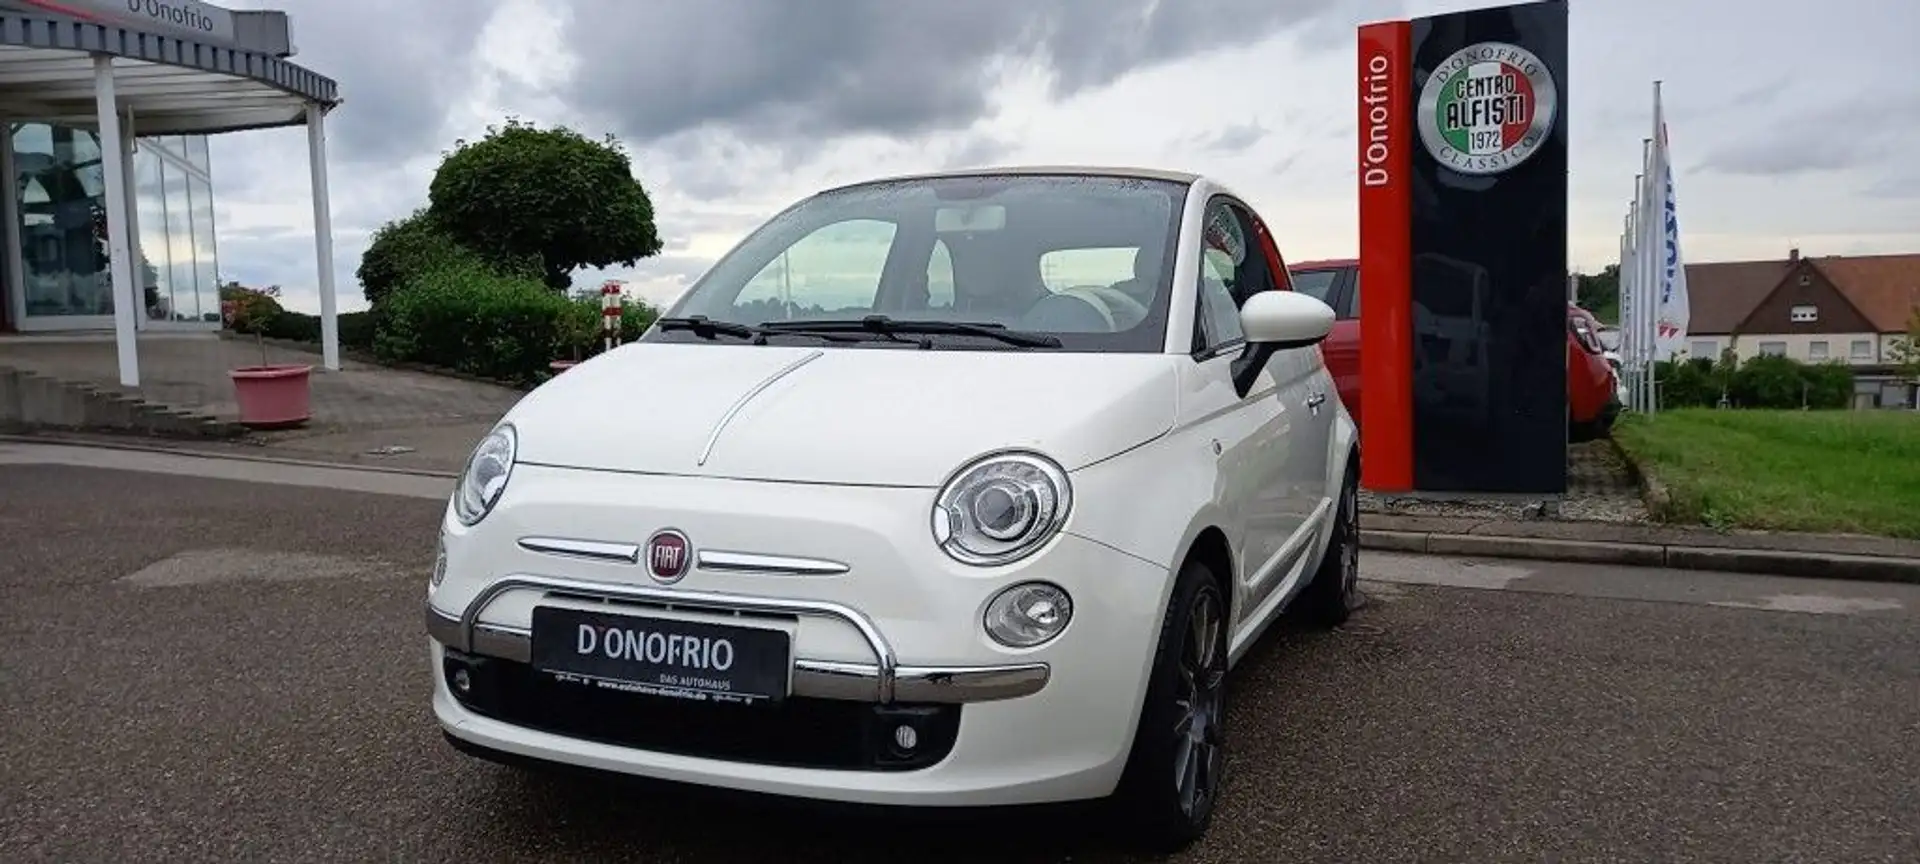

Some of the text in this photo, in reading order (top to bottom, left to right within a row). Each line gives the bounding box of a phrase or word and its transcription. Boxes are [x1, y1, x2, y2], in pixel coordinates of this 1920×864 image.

[1436, 46, 1538, 84] D'ONOFRIO
[1455, 74, 1516, 99] CENTRO
[1363, 55, 1389, 186] D'Onofrio
[1446, 95, 1526, 130] ALFISTI
[1439, 135, 1535, 171] CLASSICO
[1470, 131, 1501, 150] 1972
[654, 545, 682, 569] FIAT
[577, 624, 734, 671] D'ONOFRIO
[659, 673, 731, 691] DAS AUTOHAUS
